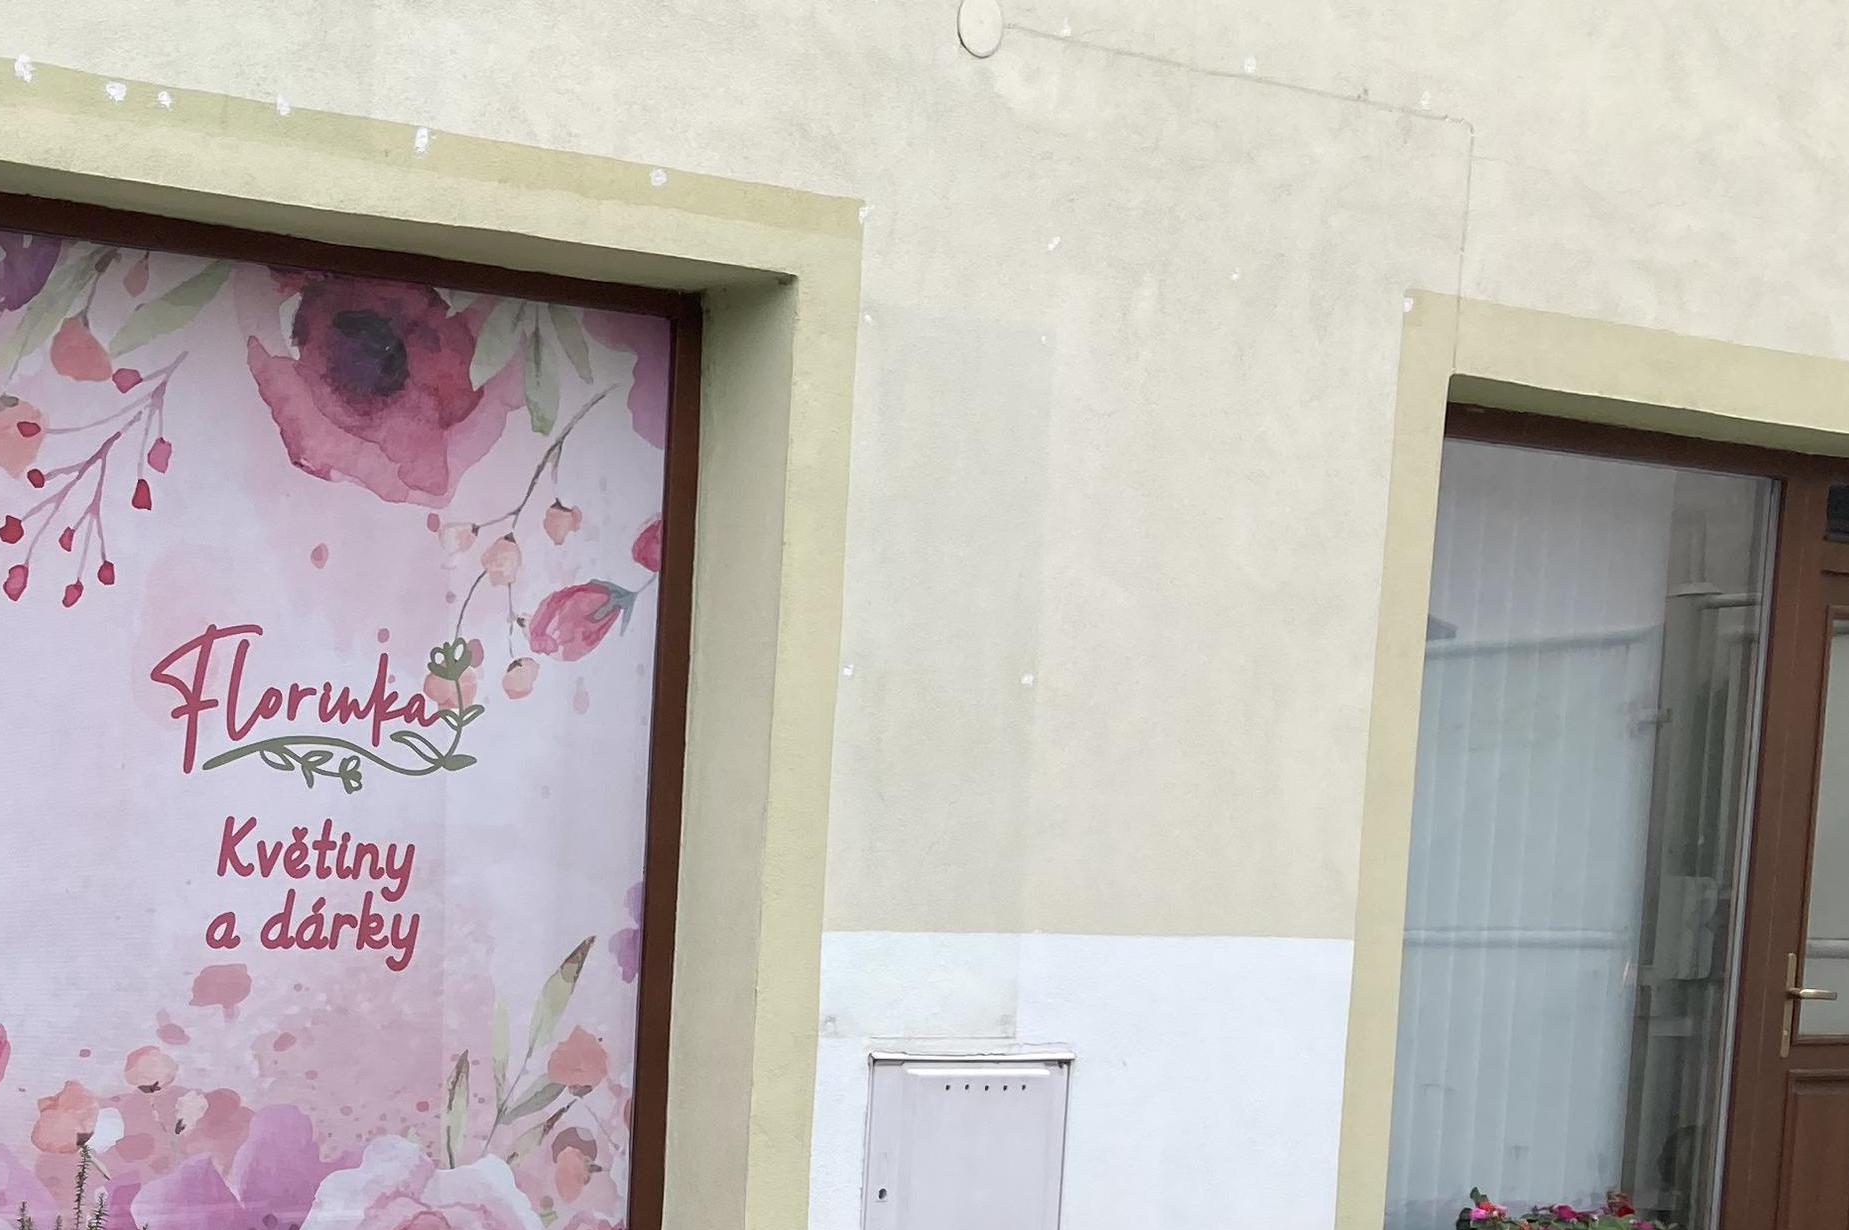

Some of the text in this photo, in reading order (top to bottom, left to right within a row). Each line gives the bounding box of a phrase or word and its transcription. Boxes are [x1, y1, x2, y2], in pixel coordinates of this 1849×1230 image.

[150, 624, 440, 774] Florinka
[216, 815, 416, 902] Květiny
[205, 888, 421, 972] a dárky
